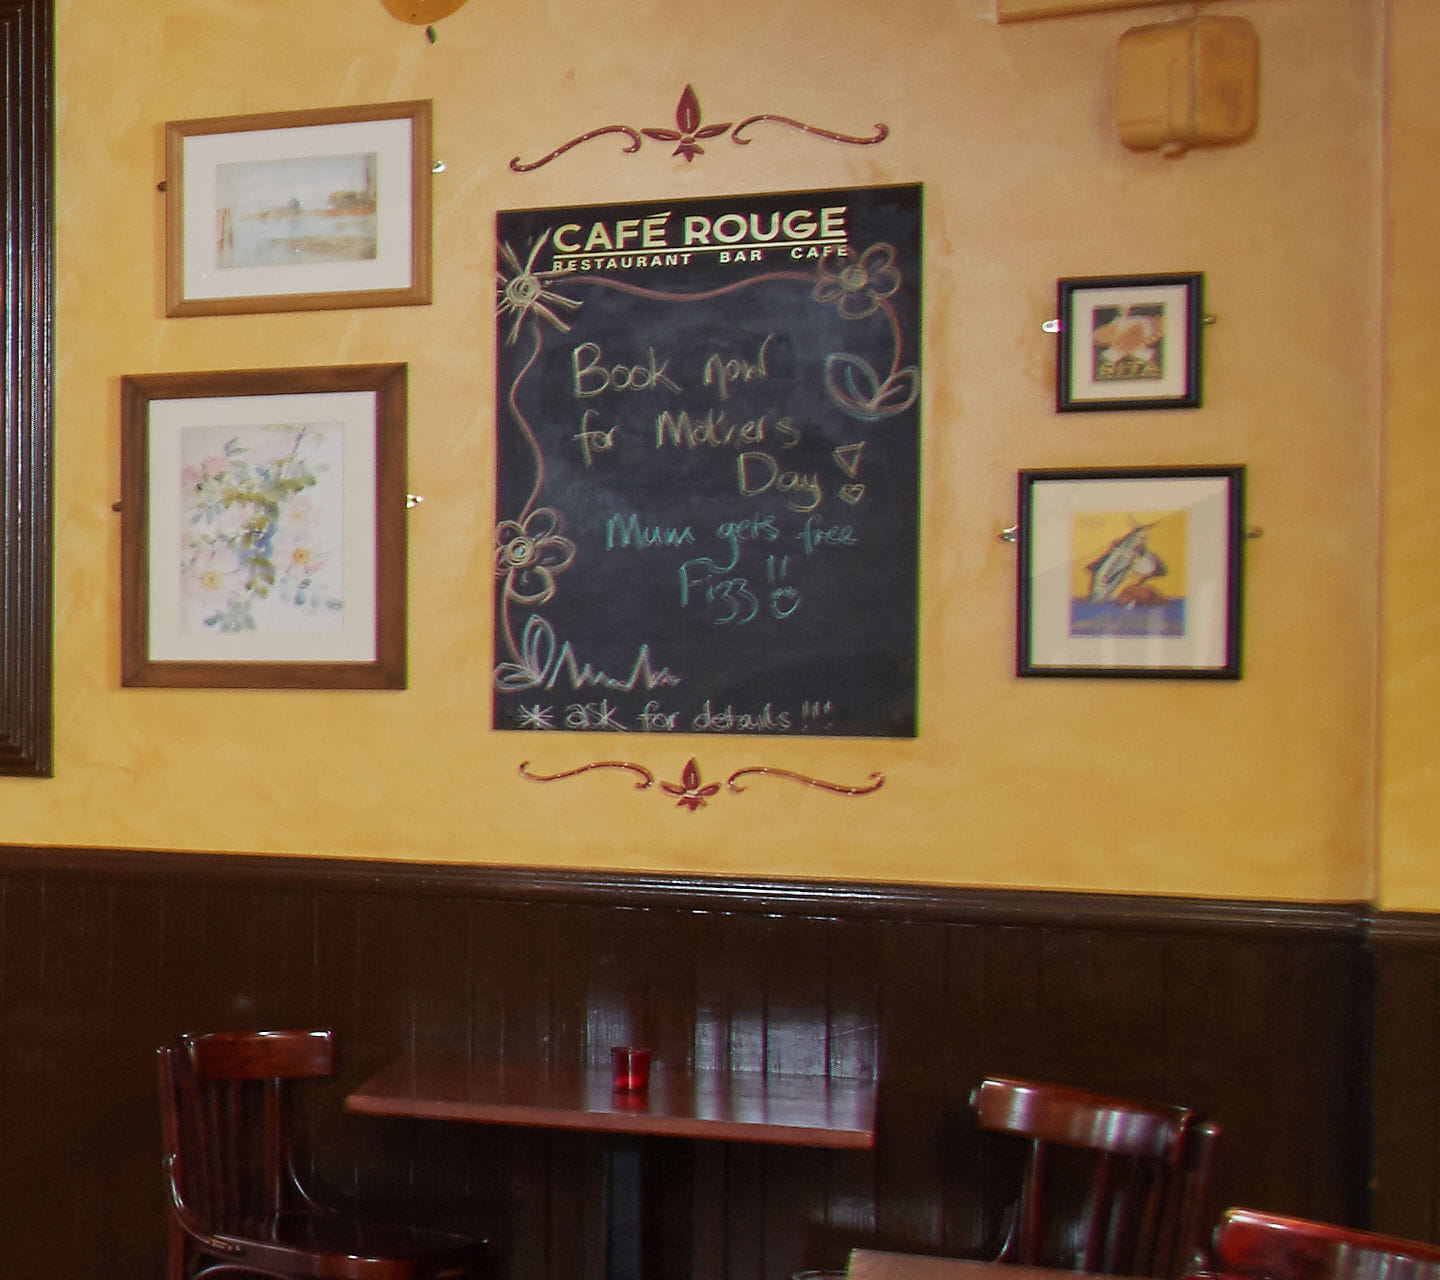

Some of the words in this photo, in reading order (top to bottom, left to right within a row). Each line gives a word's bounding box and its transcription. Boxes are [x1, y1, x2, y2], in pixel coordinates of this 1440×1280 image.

[552, 211, 672, 253] CAFÉ
[683, 206, 848, 246] ROUGE
[552, 253, 692, 273] RESTAURANT
[719, 249, 763, 263] BAR
[572, 342, 682, 398] Book
[572, 409, 621, 468] for
[737, 451, 823, 512] Day
[605, 514, 695, 551] Mum
[795, 515, 859, 555] free
[564, 698, 628, 730] ask
[636, 700, 680, 732] for
[692, 700, 792, 731] details
